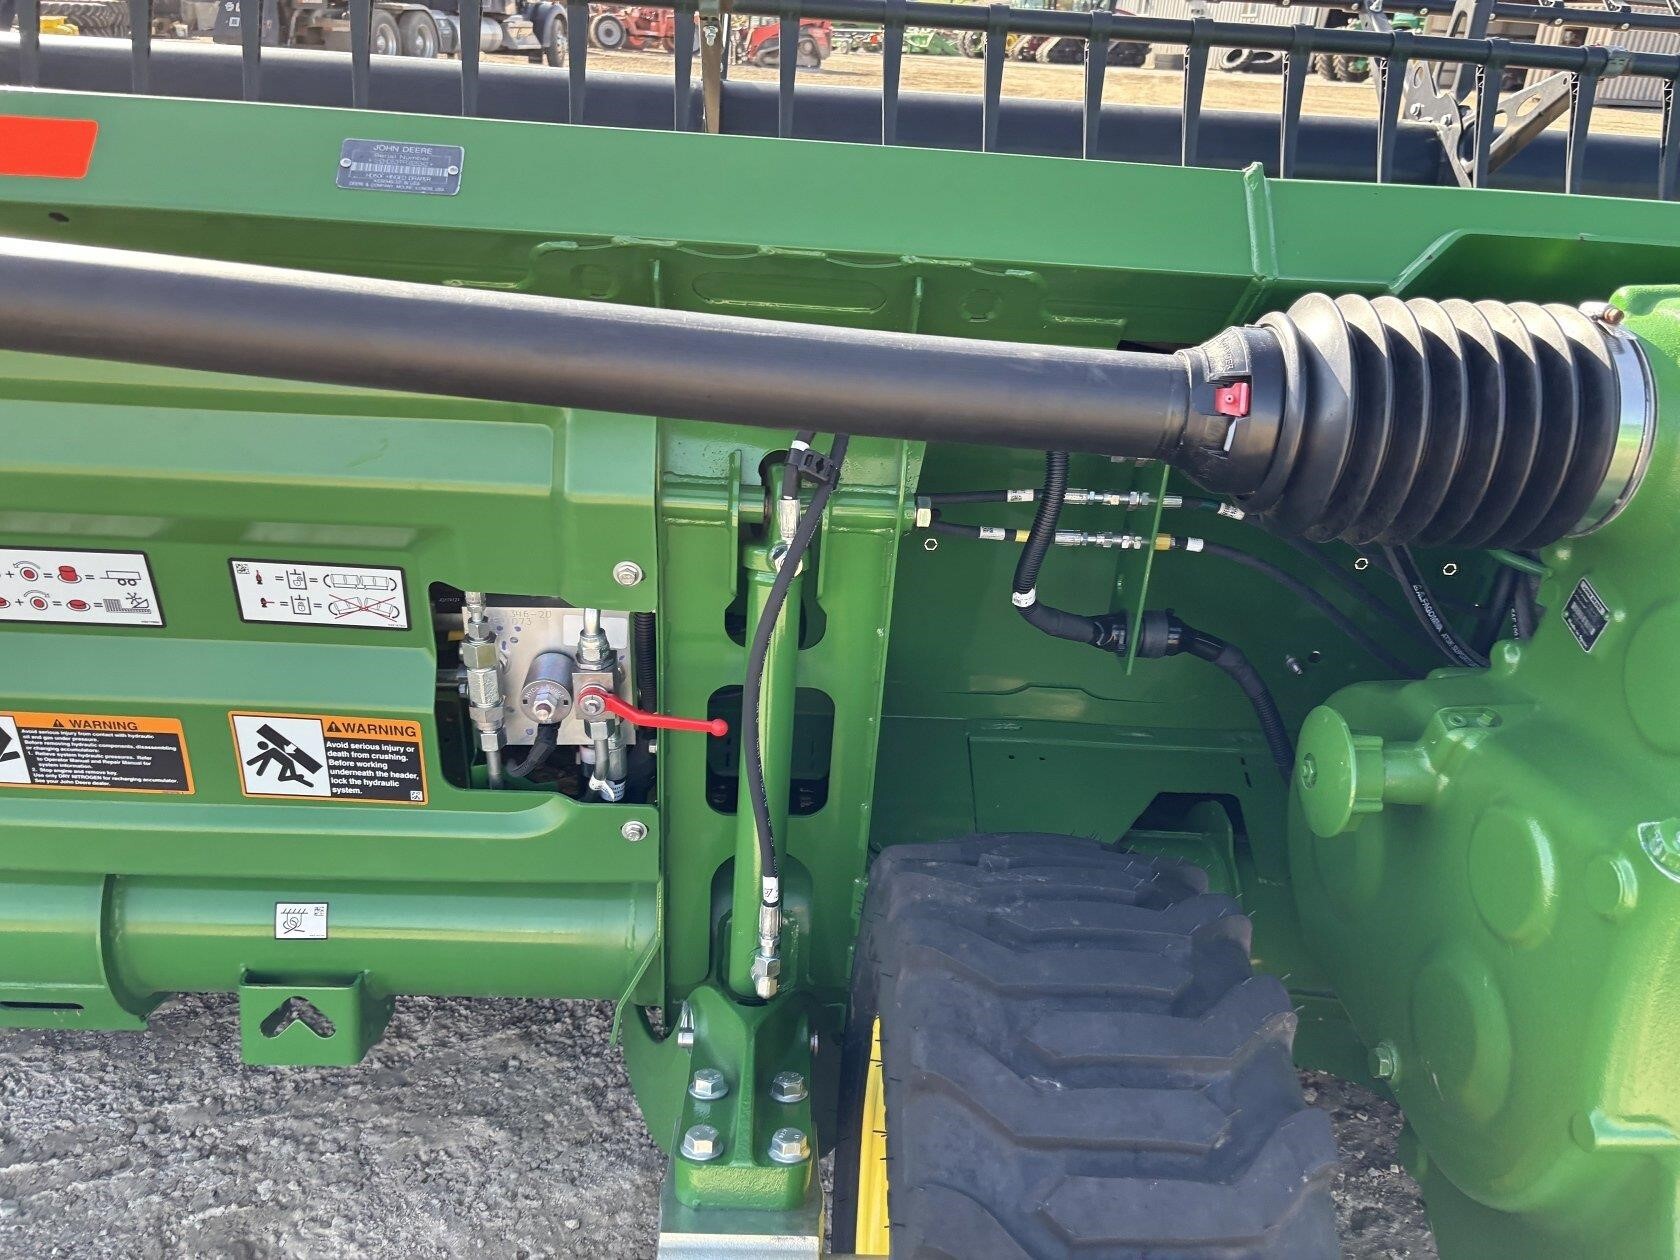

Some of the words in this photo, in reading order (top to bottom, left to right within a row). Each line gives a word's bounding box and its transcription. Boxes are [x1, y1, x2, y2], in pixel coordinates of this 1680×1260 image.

[374, 144, 399, 152] JOHN
[403, 146, 432, 154] DEERE
[69, 719, 138, 731] WARNING
[342, 723, 416, 737] WARNING
[382, 744, 404, 753] injury
[371, 753, 408, 762] crushing.
[356, 761, 388, 770] working
[390, 771, 419, 780] header,
[364, 779, 399, 787] hydraulic
